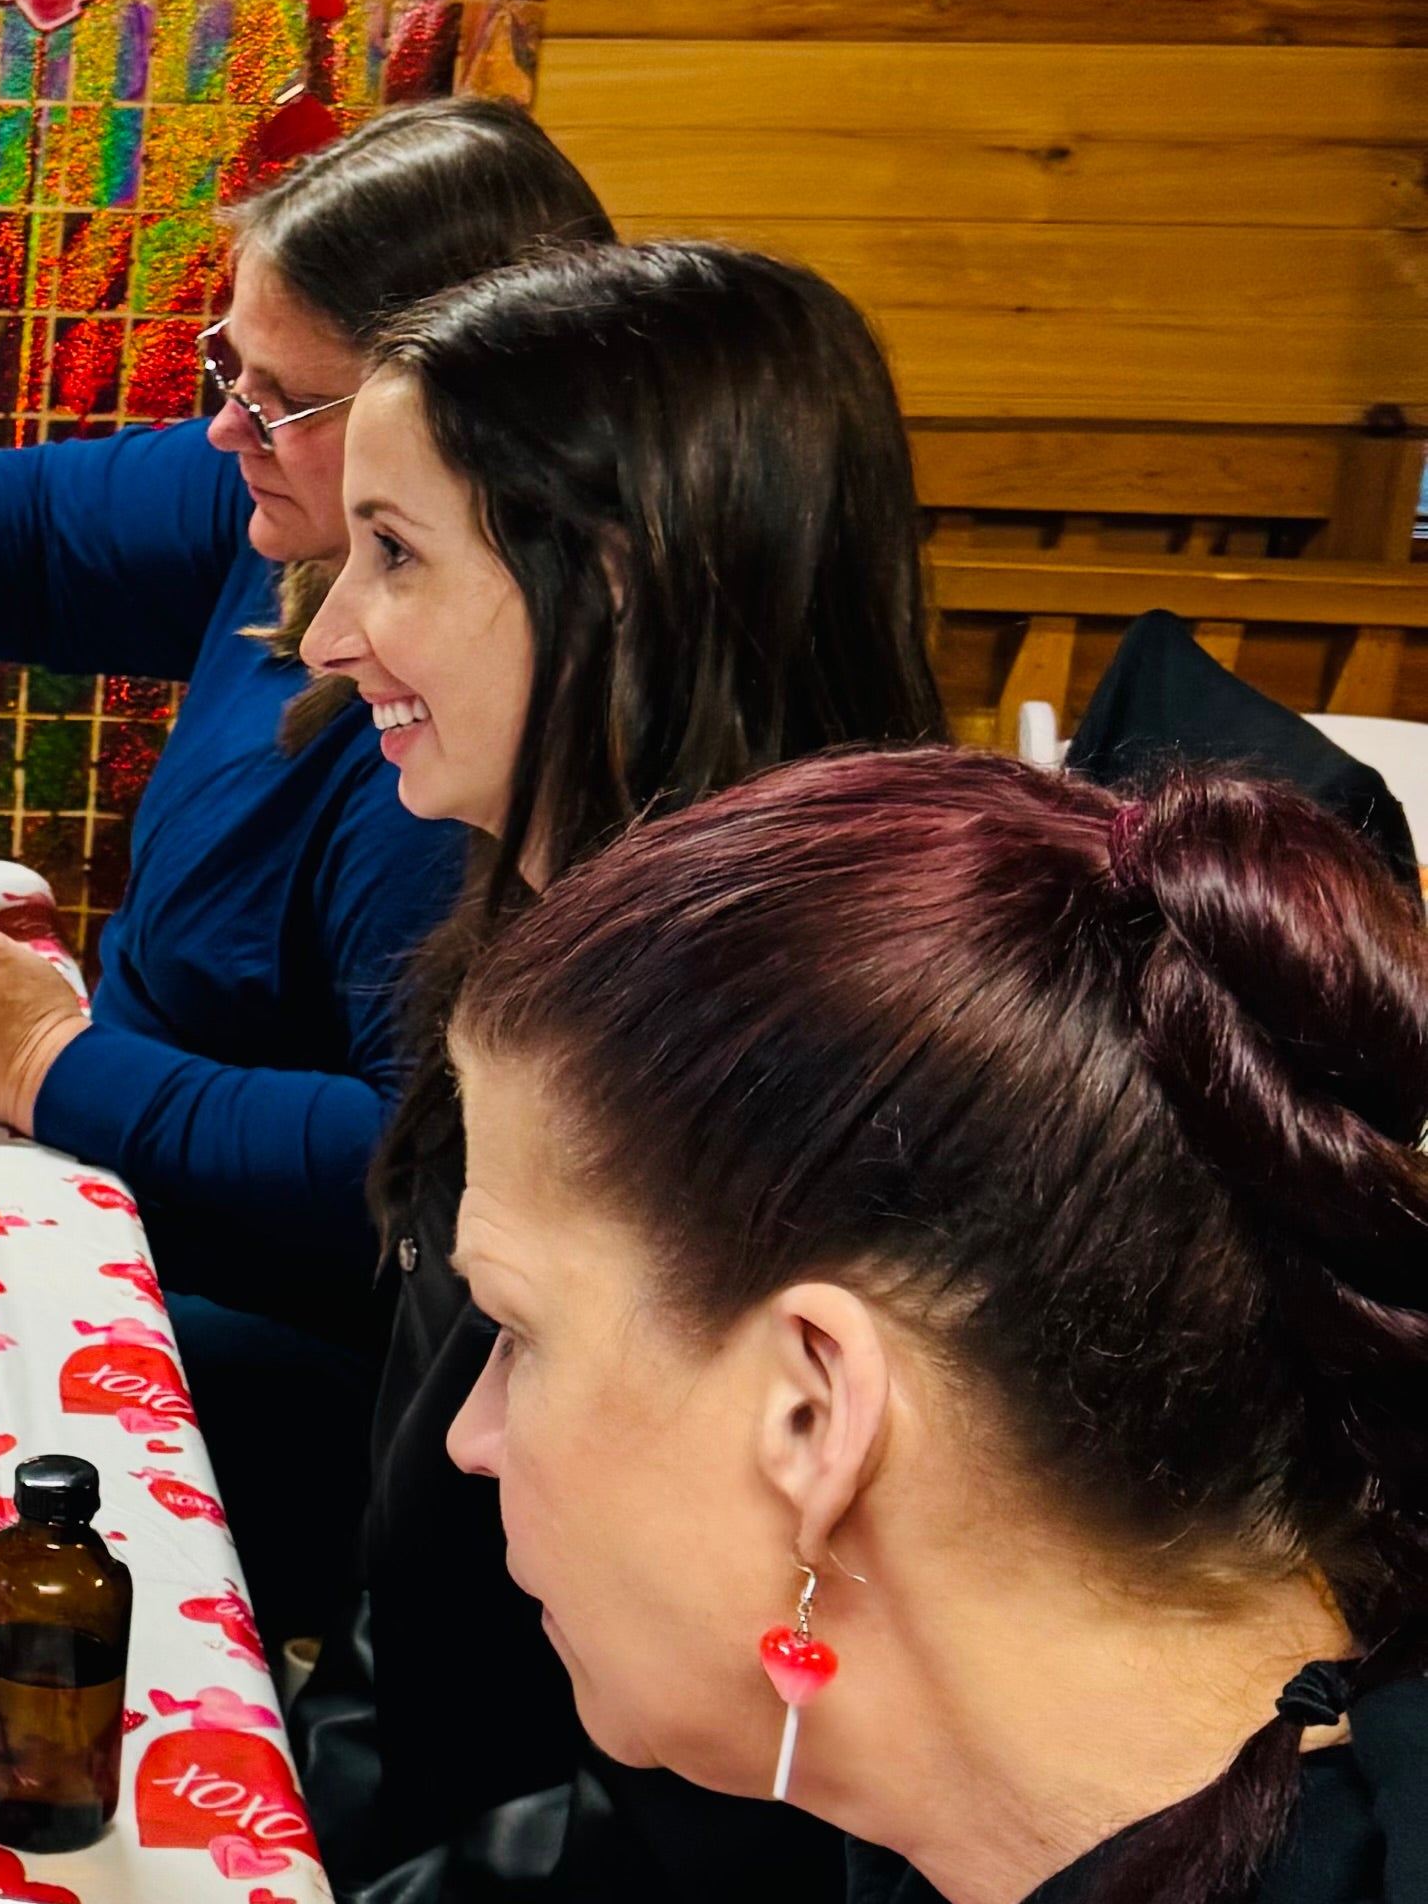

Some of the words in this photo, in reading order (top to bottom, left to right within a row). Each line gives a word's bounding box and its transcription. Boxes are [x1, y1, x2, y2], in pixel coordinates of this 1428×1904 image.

[74, 1364, 193, 1415] XOXO
[165, 1492, 214, 1512] XOXO
[153, 1765, 309, 1839] XOXO
